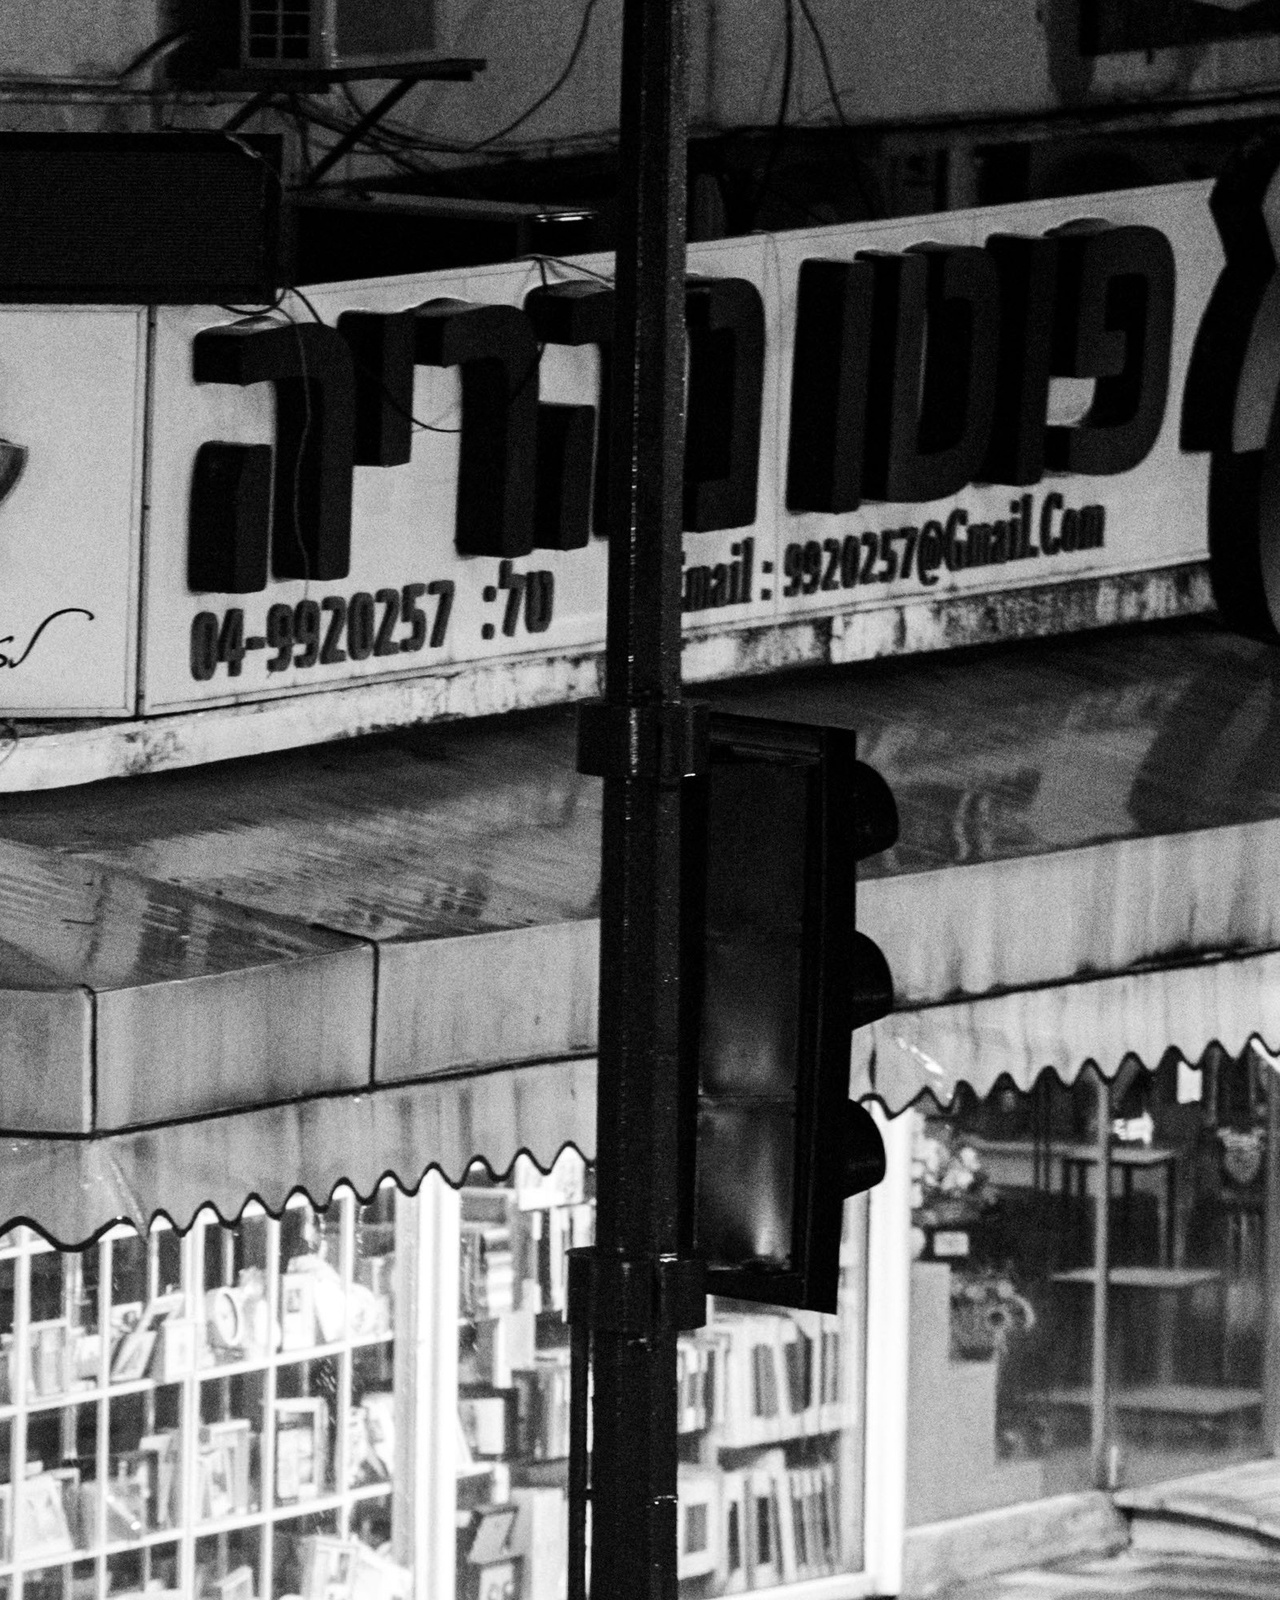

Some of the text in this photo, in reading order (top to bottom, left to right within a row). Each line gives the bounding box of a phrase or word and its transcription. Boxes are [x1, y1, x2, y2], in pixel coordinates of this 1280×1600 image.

[787, 217, 1176, 514] פוטו
[682, 537, 754, 612] mail
[190, 580, 455, 681] 04-9920257
